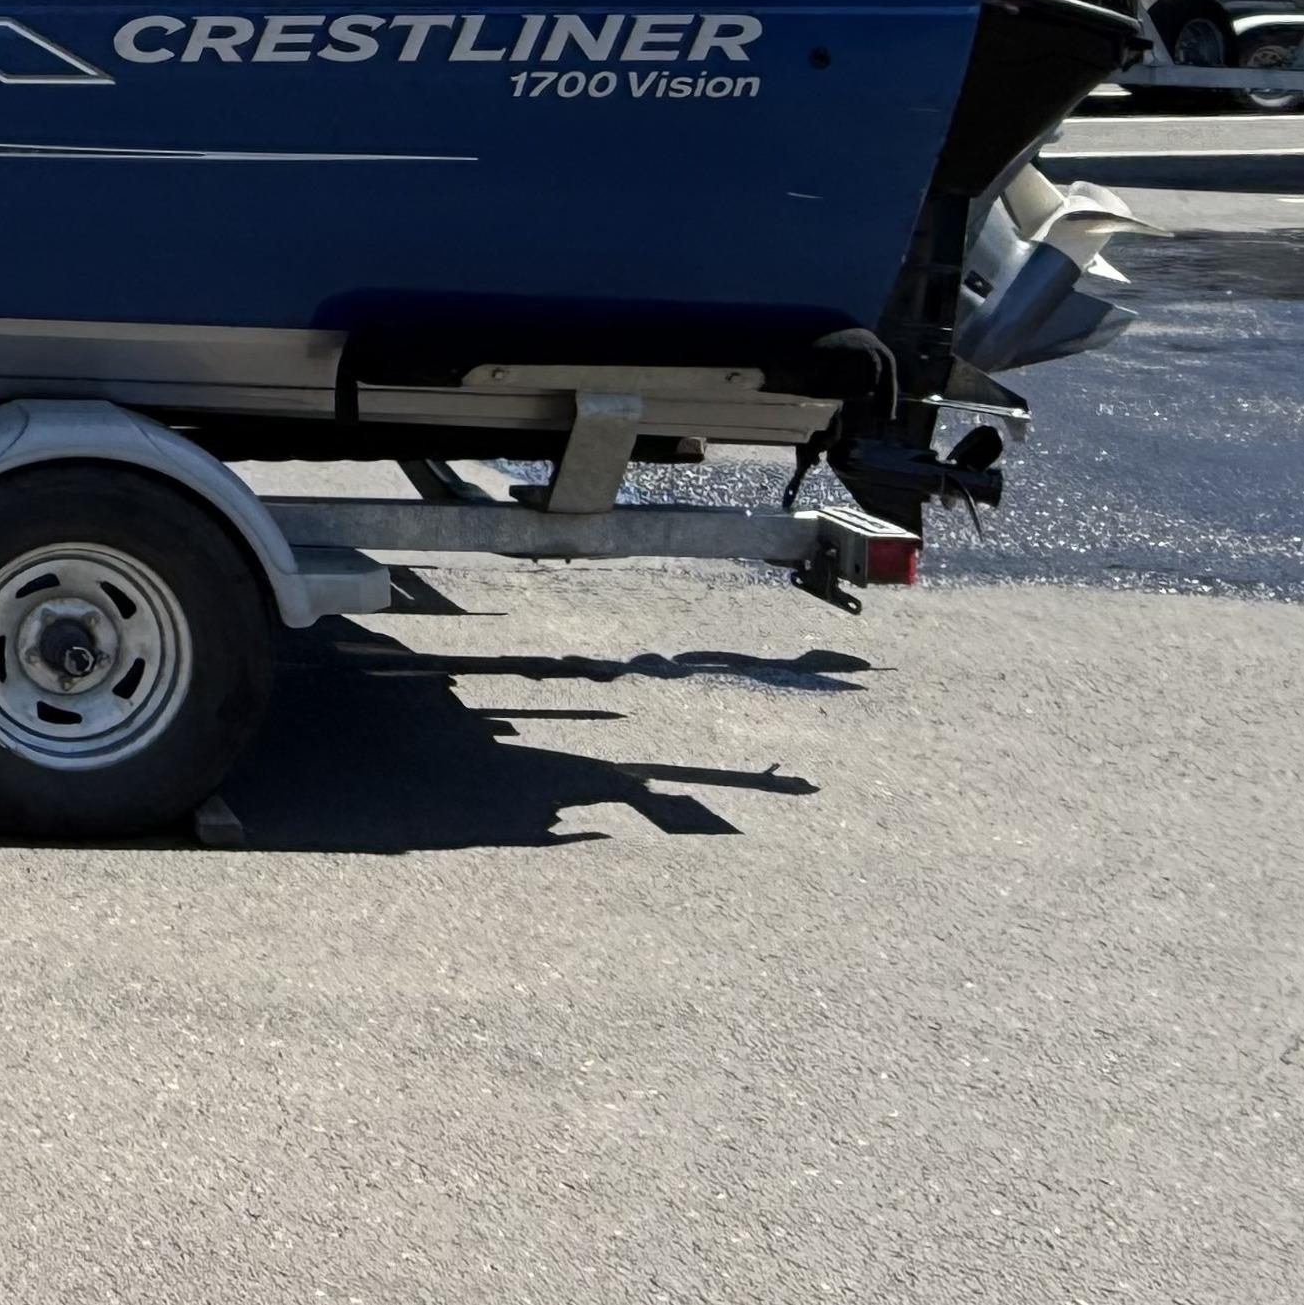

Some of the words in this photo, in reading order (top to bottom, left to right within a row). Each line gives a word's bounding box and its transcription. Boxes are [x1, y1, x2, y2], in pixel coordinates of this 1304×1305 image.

[113, 14, 763, 62] CRESTLINER
[509, 70, 617, 98] 1700
[628, 70, 761, 98] Vision
